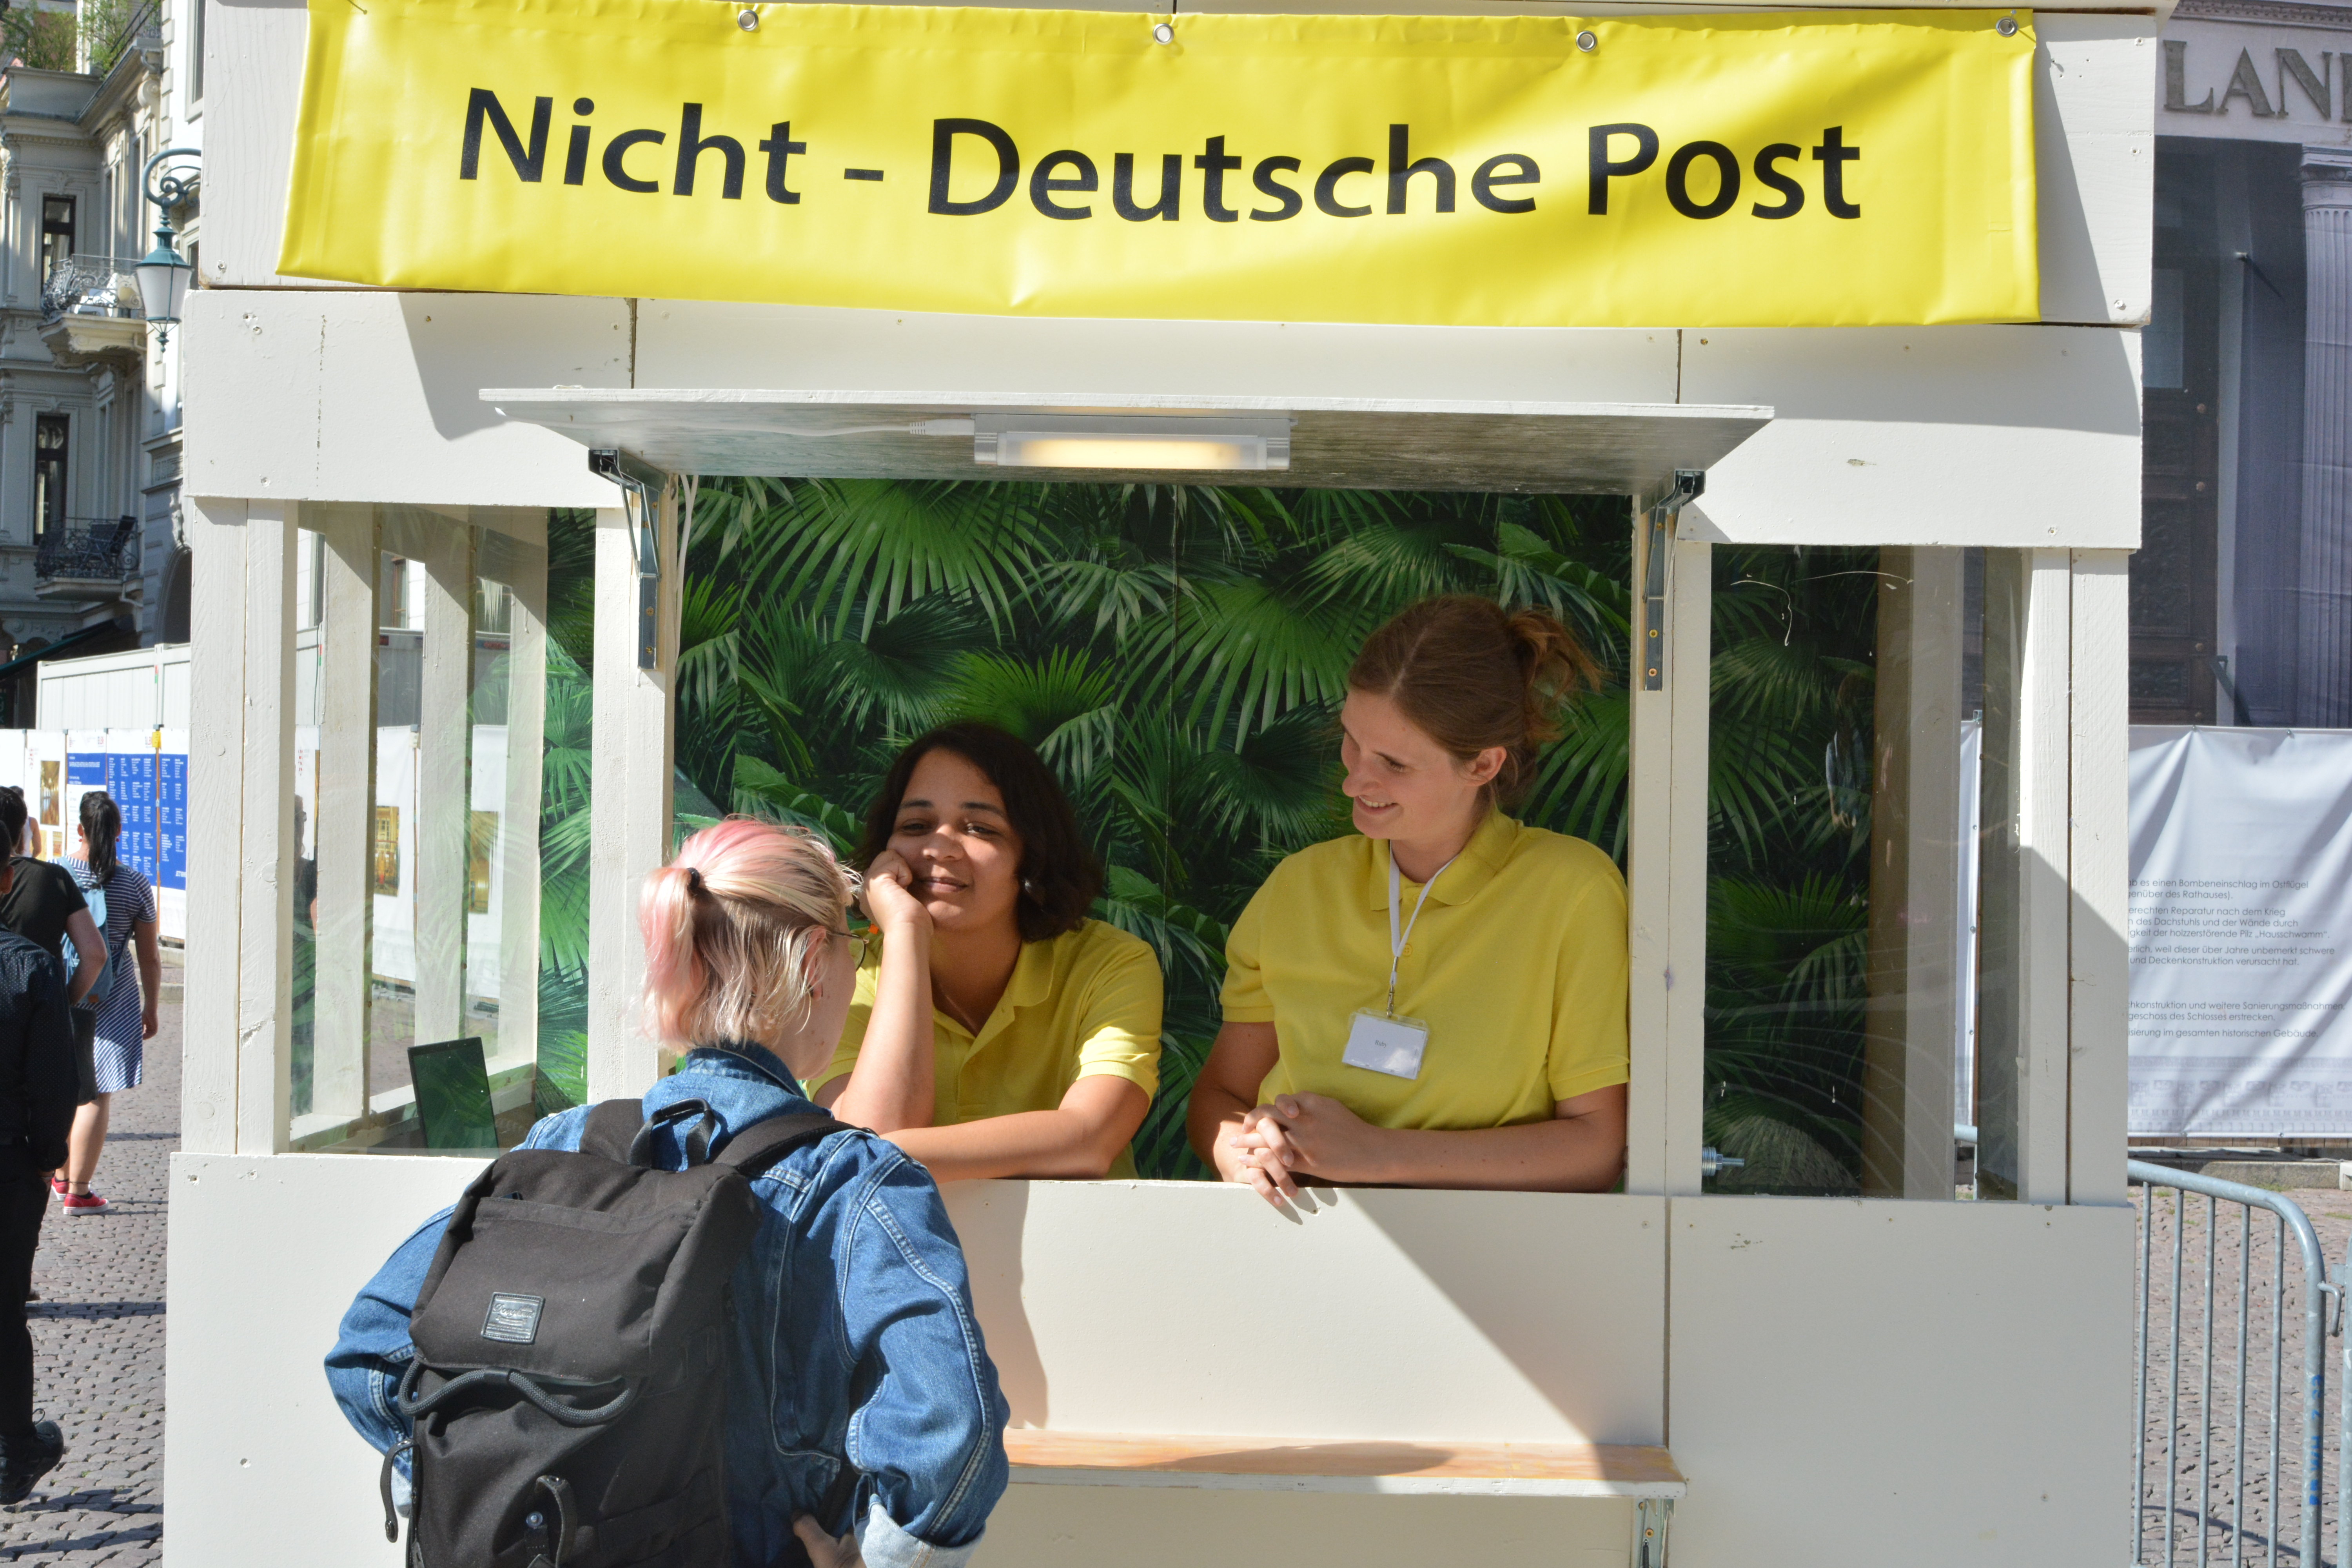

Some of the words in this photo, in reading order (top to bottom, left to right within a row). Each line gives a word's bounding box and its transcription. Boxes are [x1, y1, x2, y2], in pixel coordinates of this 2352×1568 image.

[2163, 40, 2352, 123] LAN
[461, 88, 806, 204] Nicht
[845, 169, 883, 180] -
[929, 118, 1539, 222] Deutsche
[1589, 124, 1860, 219] Post
[2179, 879, 2257, 889] Bombeneinschlag
[2272, 880, 2308, 890] Ostflügel
[2183, 890, 2233, 900] Rathauses).
[2171, 907, 2214, 916] Reparatur
[2264, 908, 2285, 917] Krieg
[2154, 918, 2200, 926] Dachstuhls
[2129, 929, 2151, 938] gkeit
[2170, 929, 2237, 938] holzzerstörende
[2149, 956, 2233, 965] Deckenkonstruktion
[2176, 1029, 2220, 1038] gesamten
[2222, 1029, 2271, 1037] historischen
[2273, 1029, 2318, 1038] Gebäude.
